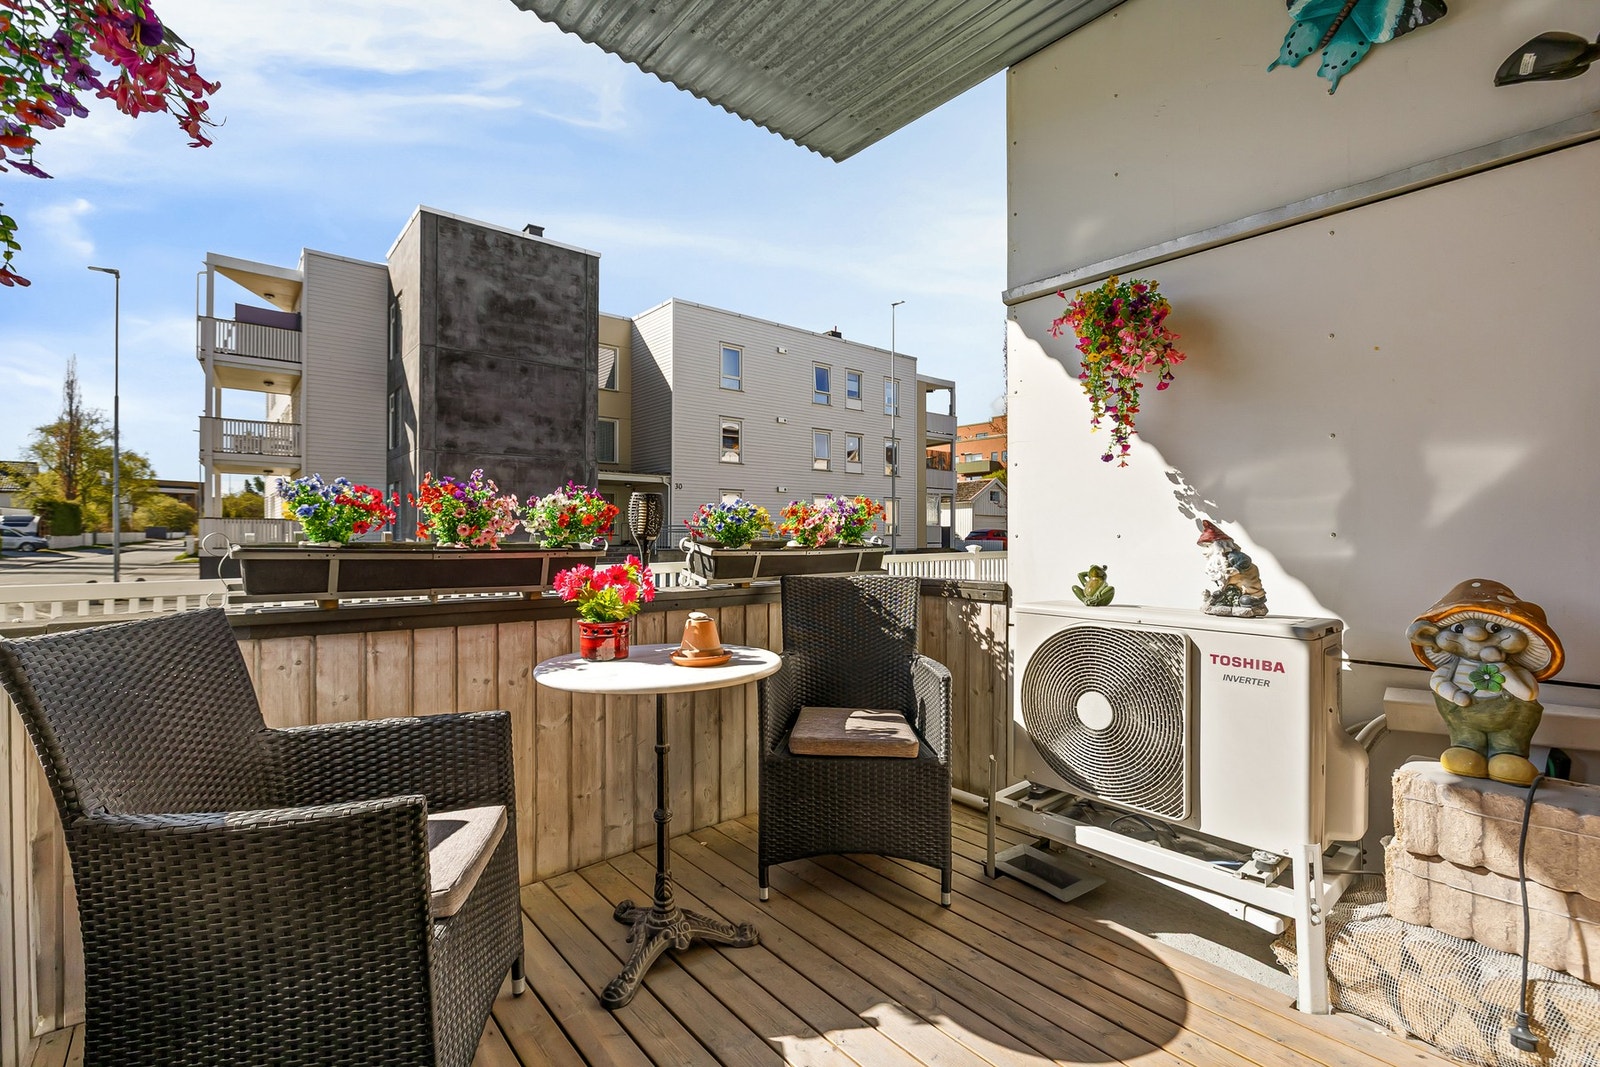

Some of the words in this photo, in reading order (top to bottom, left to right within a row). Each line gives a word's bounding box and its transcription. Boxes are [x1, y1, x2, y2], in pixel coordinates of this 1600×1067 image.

[674, 482, 683, 490] 30
[1210, 653, 1285, 673] TOSHIBA
[1222, 674, 1271, 687] INVERTER
